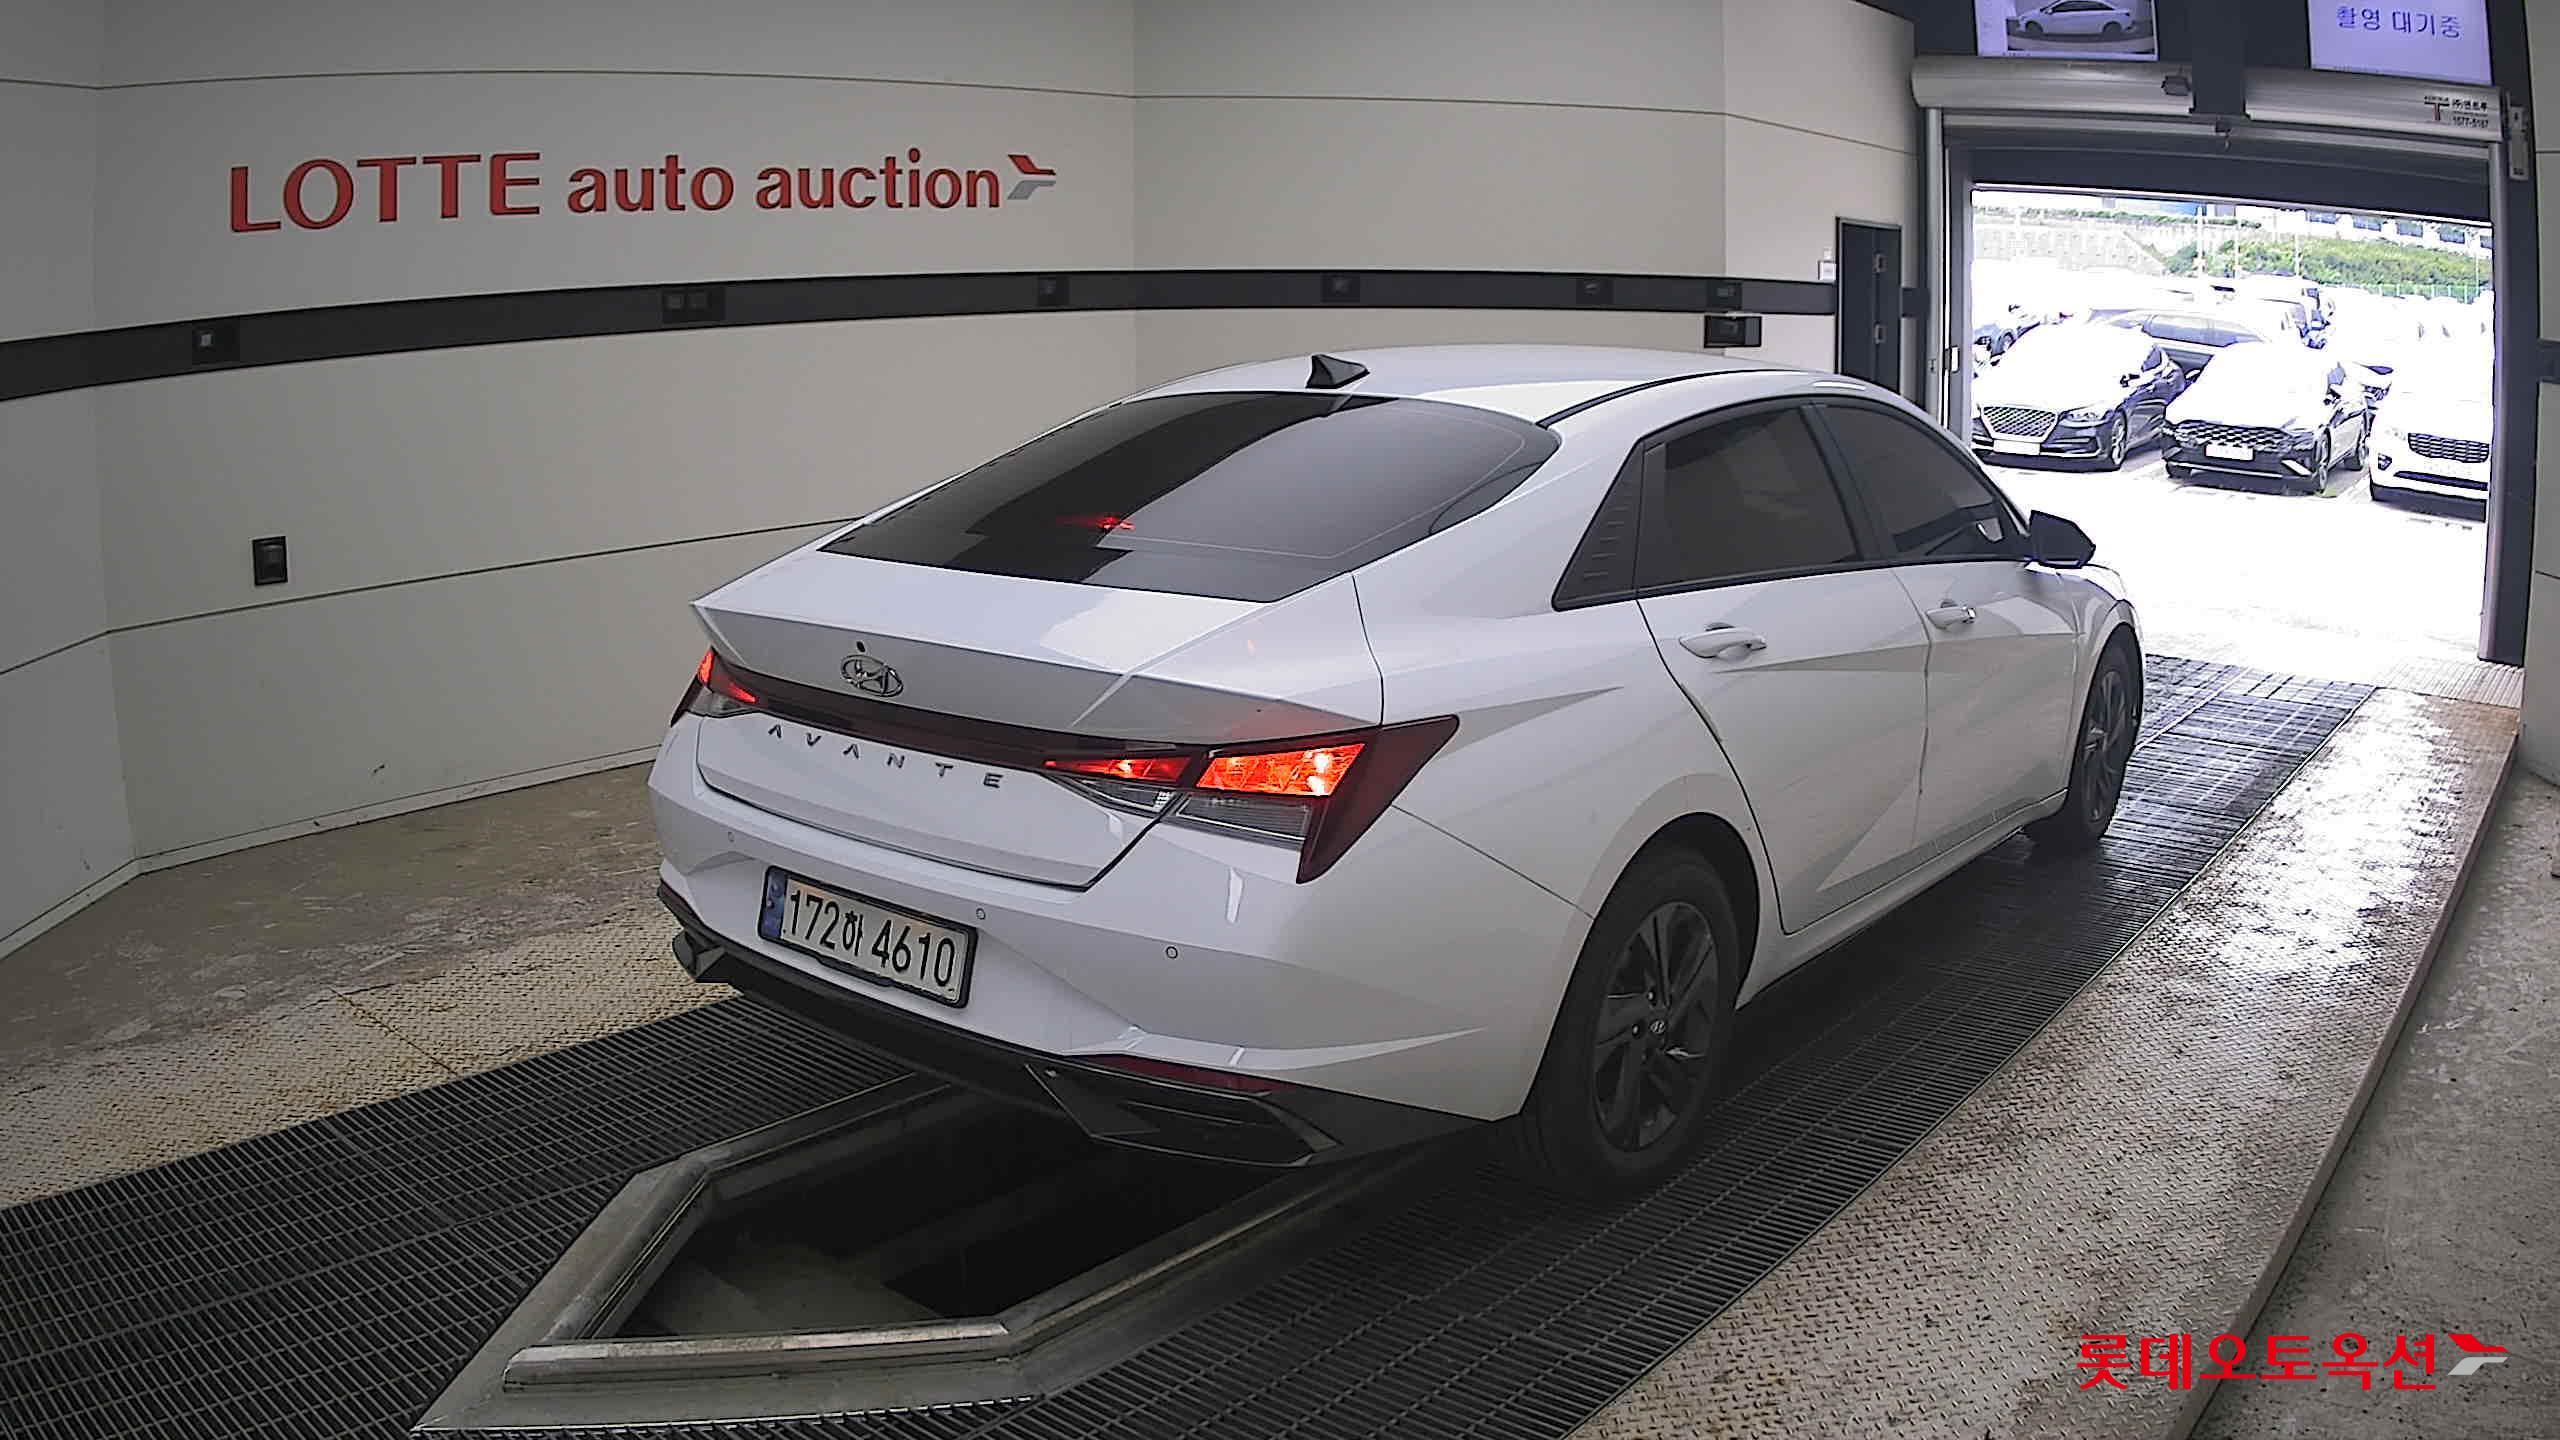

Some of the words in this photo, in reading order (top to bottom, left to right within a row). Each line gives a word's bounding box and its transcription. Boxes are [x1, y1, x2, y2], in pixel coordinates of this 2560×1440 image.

[2336, 6, 2382, 31] 촬영
[2392, 10, 2461, 39] 대기중
[230, 152, 541, 233] LOTTE
[568, 154, 736, 214] auto
[756, 147, 1001, 209] auction
[768, 724, 1003, 788] AVANTE
[790, 889, 864, 957] 172하
[872, 919, 956, 987] 4610
